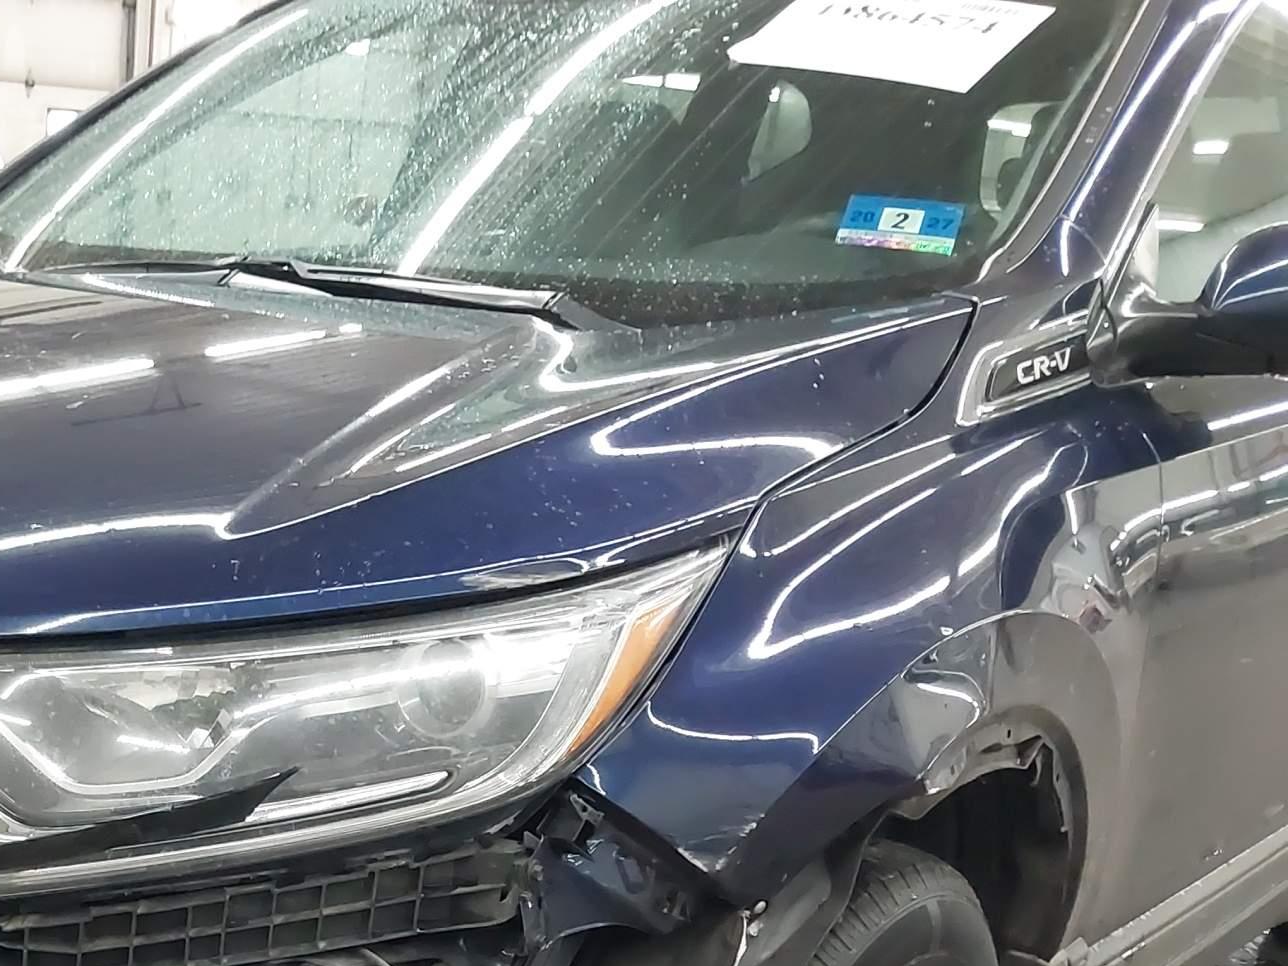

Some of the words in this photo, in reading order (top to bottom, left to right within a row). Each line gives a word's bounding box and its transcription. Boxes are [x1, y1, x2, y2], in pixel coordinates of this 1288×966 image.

[849, 210, 876, 223] 20
[890, 212, 910, 230] 2
[926, 217, 955, 231] 27
[1016, 347, 1071, 385] CR-V
